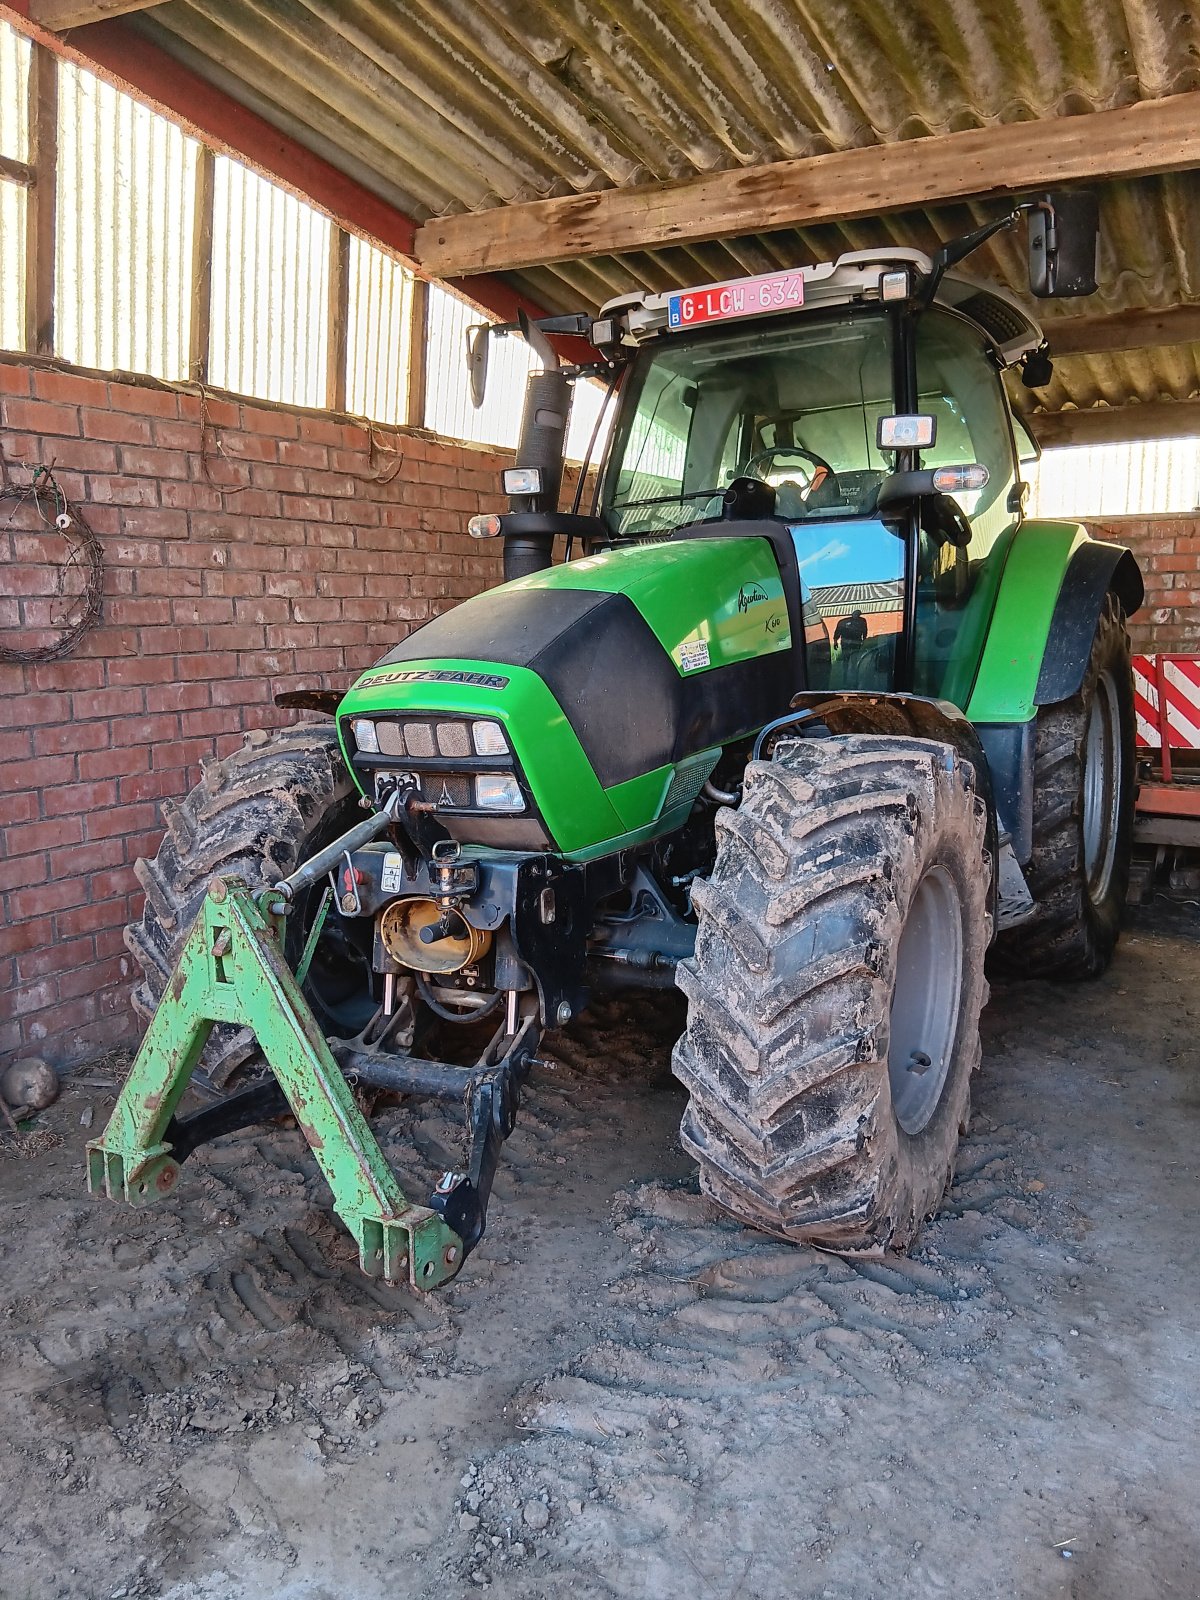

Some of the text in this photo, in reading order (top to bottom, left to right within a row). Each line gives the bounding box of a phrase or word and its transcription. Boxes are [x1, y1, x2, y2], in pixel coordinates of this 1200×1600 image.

[682, 278, 799, 320] G-LCW-634
[672, 313, 679, 324] B
[358, 670, 503, 688] DEUTZ-FAHR
